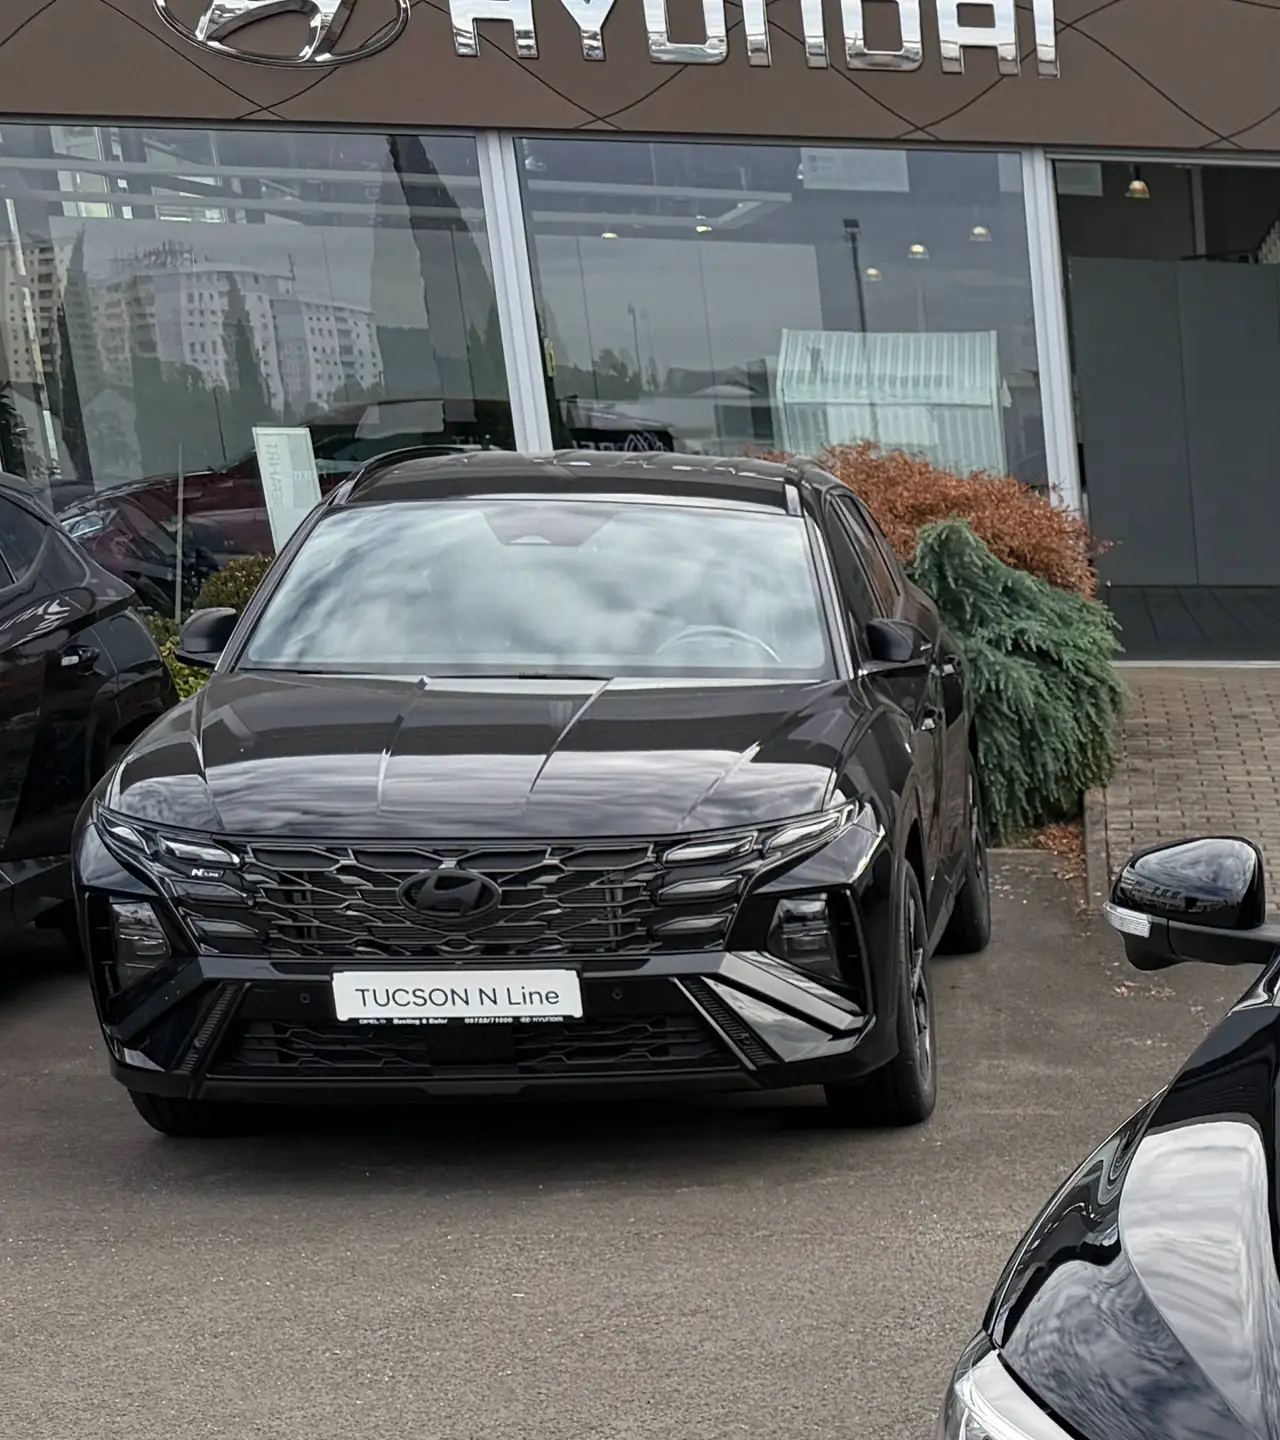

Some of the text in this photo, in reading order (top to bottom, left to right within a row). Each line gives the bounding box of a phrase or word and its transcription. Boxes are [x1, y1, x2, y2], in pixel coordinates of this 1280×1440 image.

[355, 985, 560, 1007] TUCSON N Line
